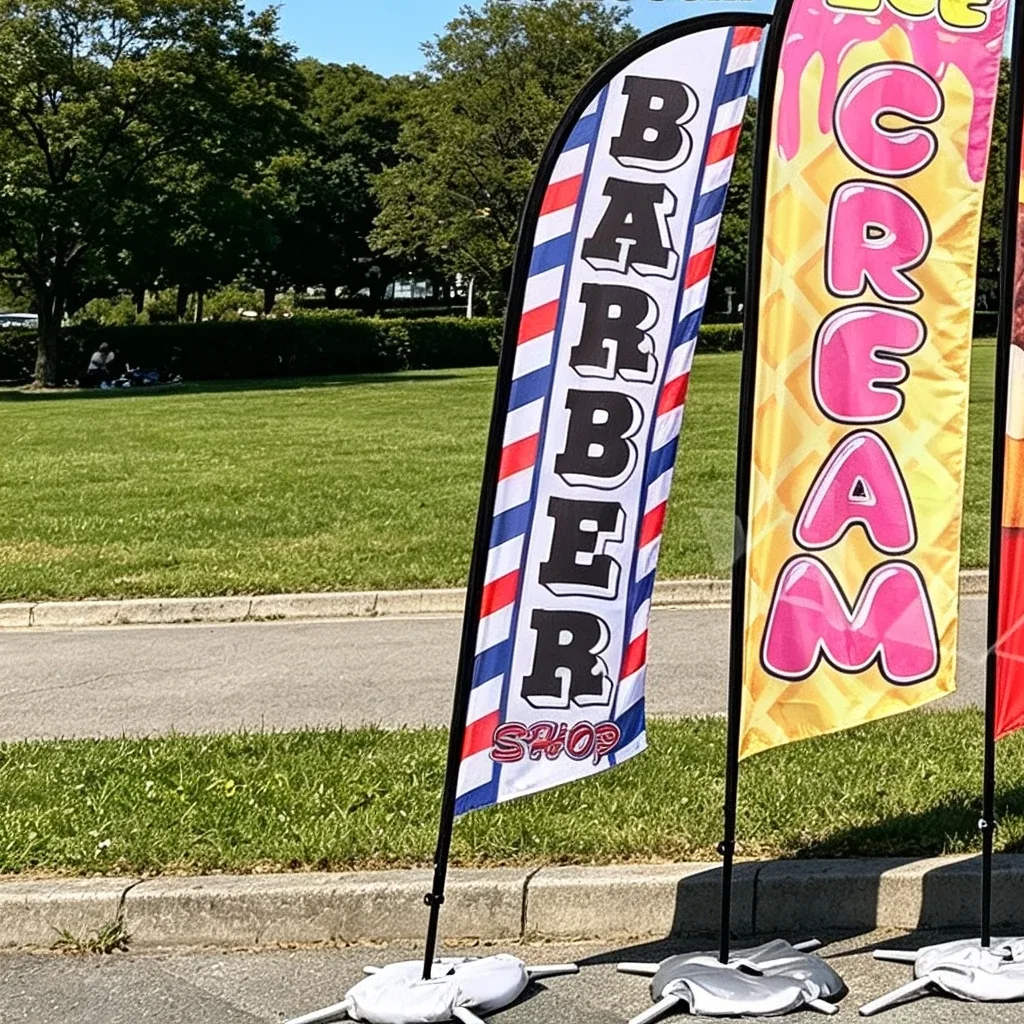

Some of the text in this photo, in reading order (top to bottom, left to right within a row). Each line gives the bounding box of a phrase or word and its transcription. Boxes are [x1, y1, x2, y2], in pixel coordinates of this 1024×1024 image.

[522, 74, 699, 709] BARBER
[762, 61, 943, 686] CREAM
[489, 720, 621, 765] SHOP
